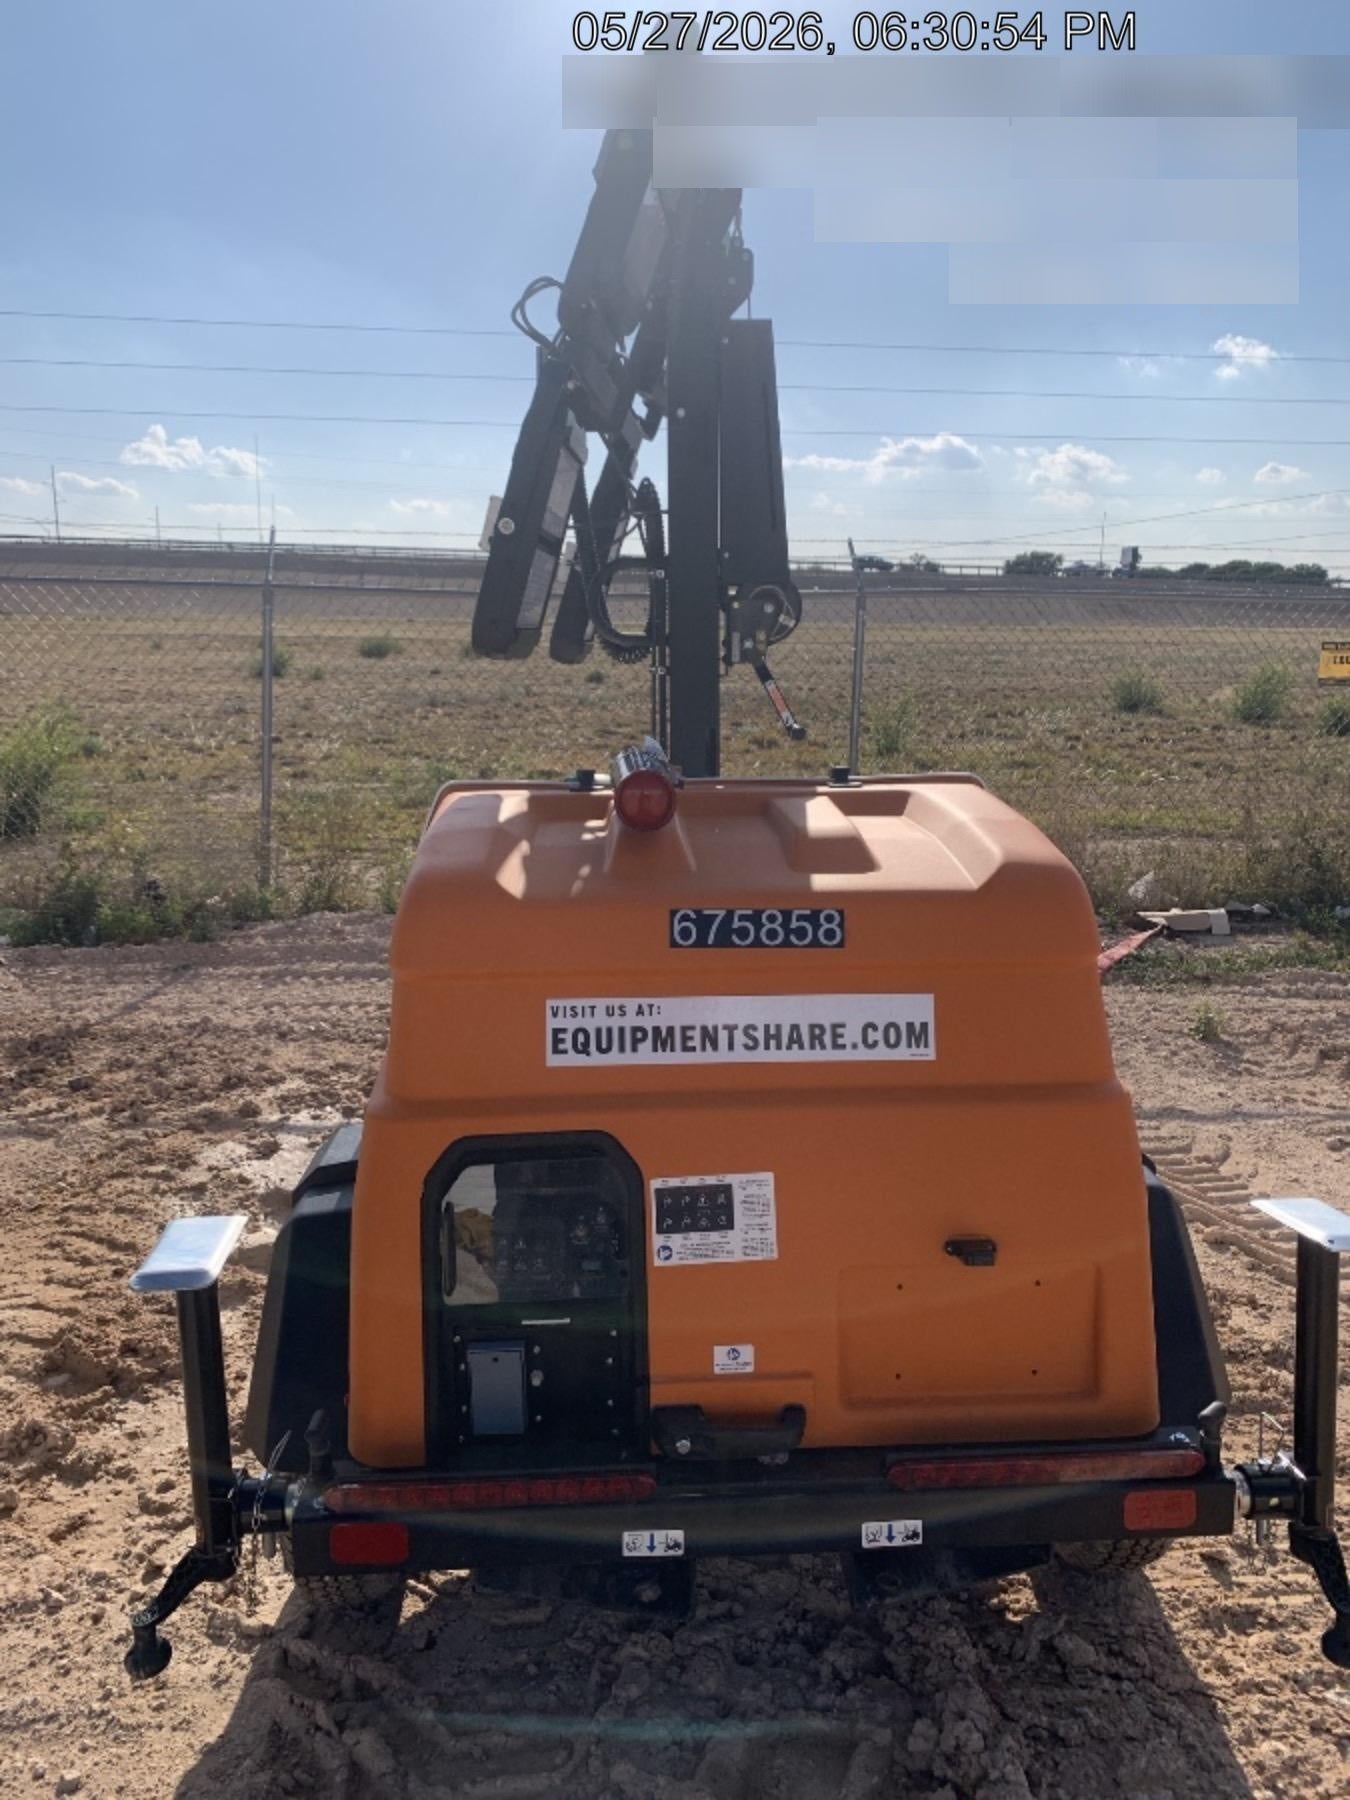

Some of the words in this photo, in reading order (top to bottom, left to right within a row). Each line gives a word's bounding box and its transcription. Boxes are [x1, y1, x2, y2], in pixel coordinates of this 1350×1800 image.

[672, 909, 843, 946] 675858
[550, 1005, 597, 1019] VISIT
[605, 1004, 628, 1018] US
[635, 1003, 663, 1017] AT:
[550, 1021, 930, 1057] EQUIPMENTSHARE.COM
